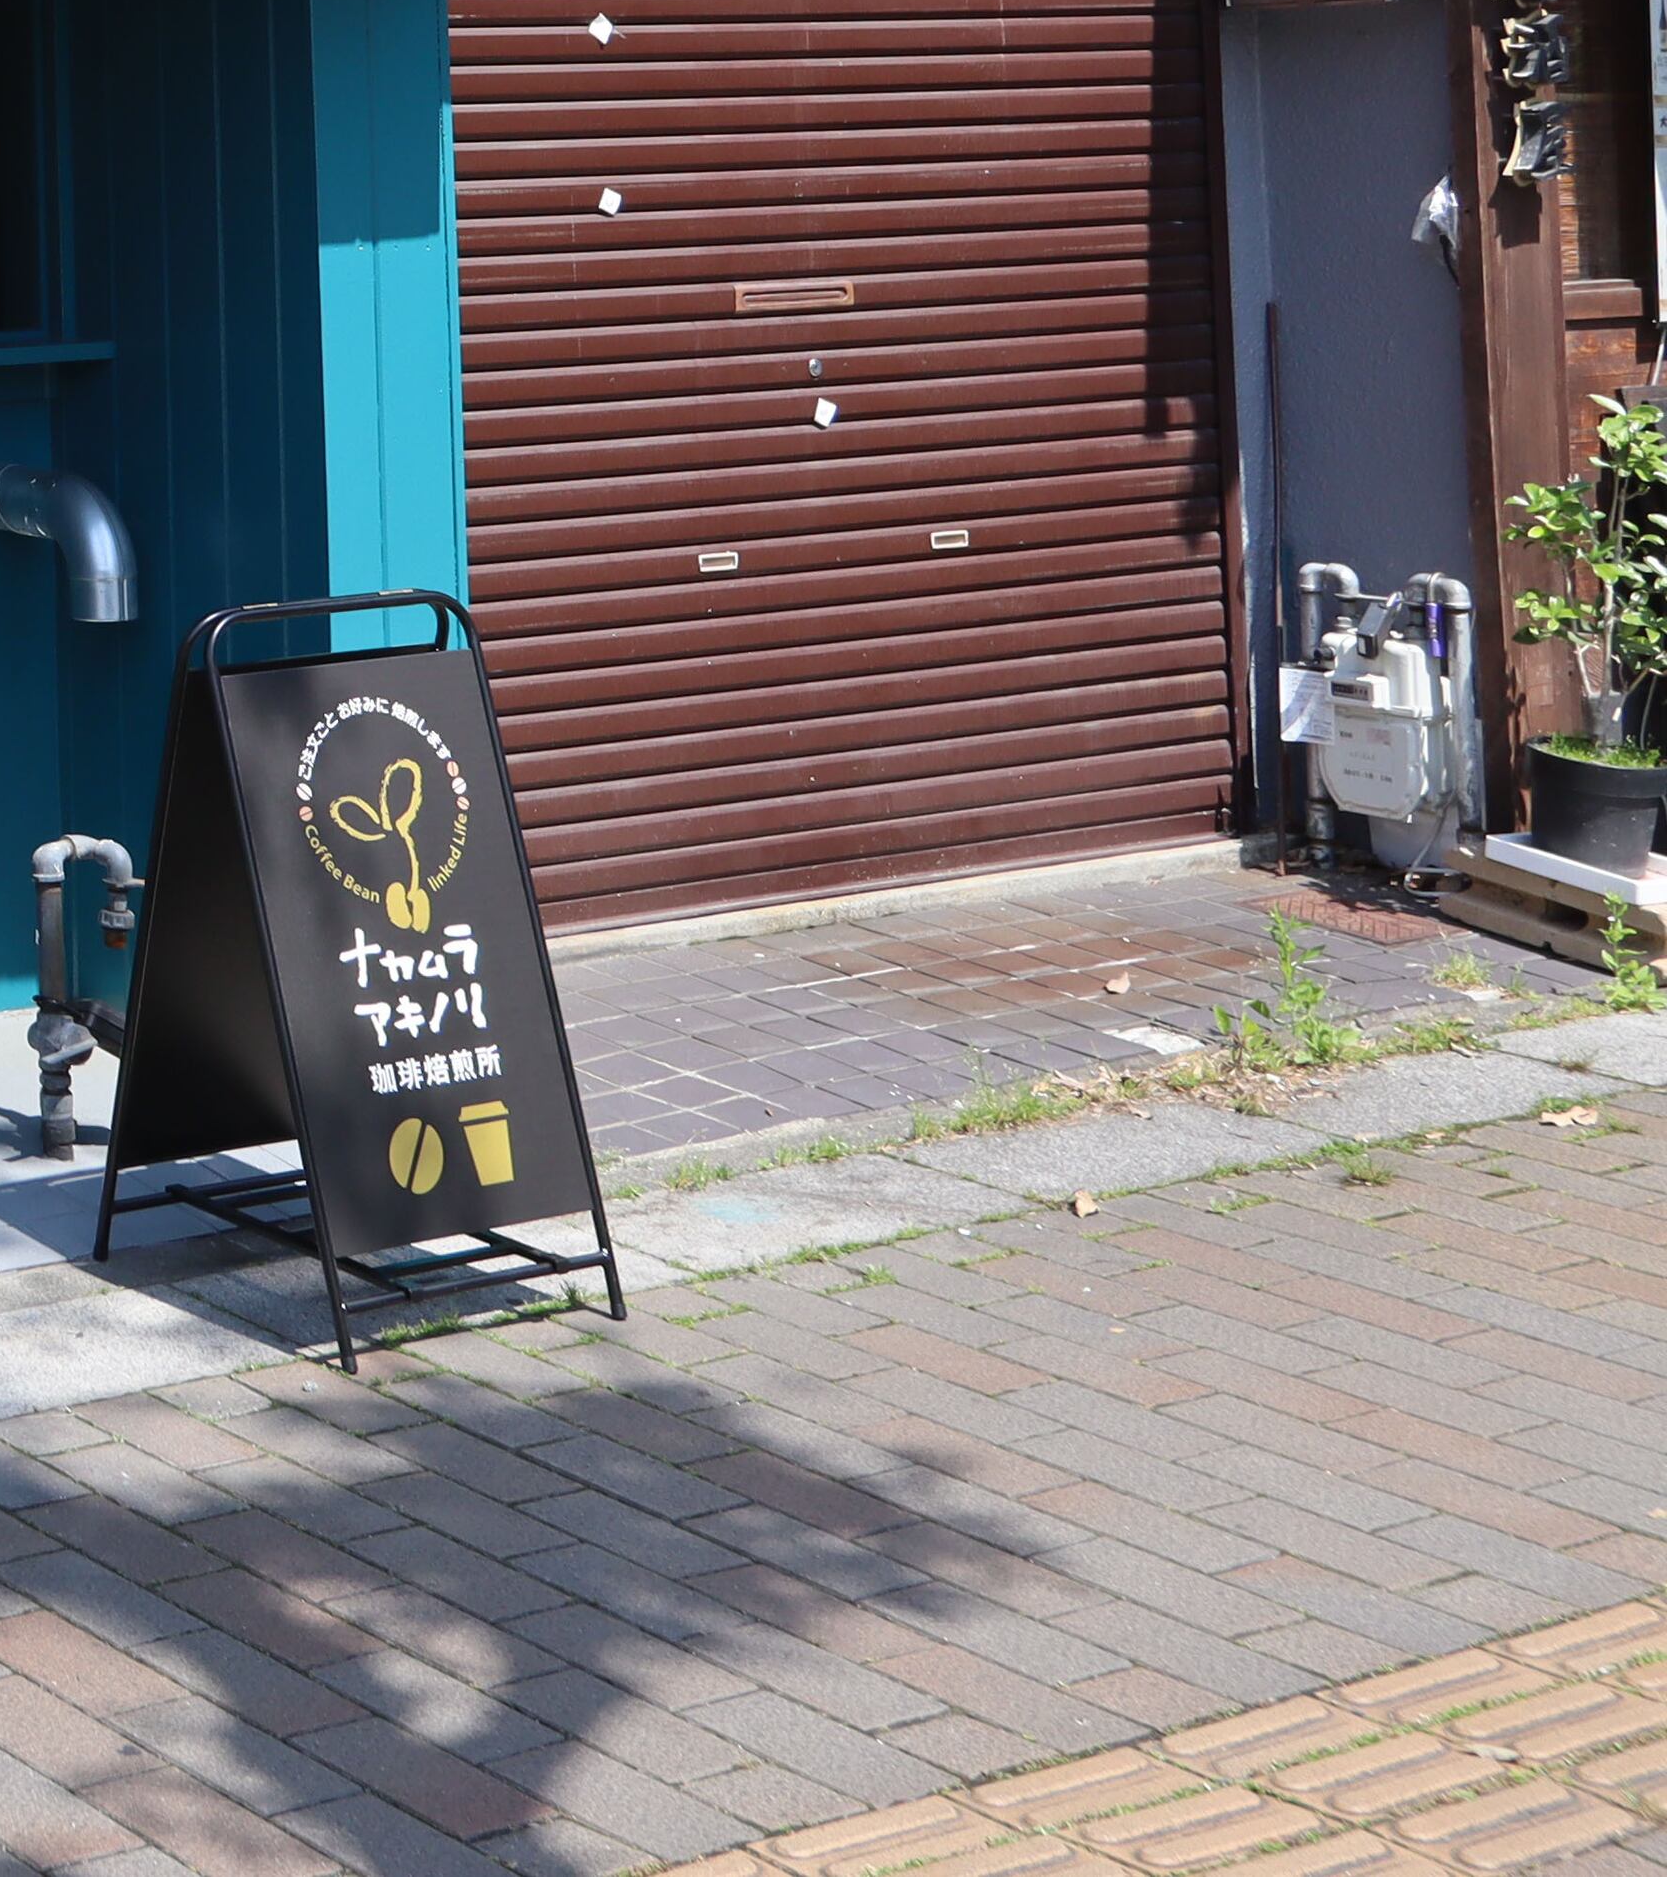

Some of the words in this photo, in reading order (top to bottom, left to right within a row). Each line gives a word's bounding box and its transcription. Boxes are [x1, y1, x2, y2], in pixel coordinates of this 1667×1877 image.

[305, 824, 344, 881] Coffee
[342, 873, 381, 904] Bean
[426, 844, 463, 892] linked
[452, 812, 468, 847] Life
[338, 923, 479, 989] ナカムラ
[353, 982, 488, 1048] アキノリ
[368, 1043, 503, 1095] 珈琲焙煎所
